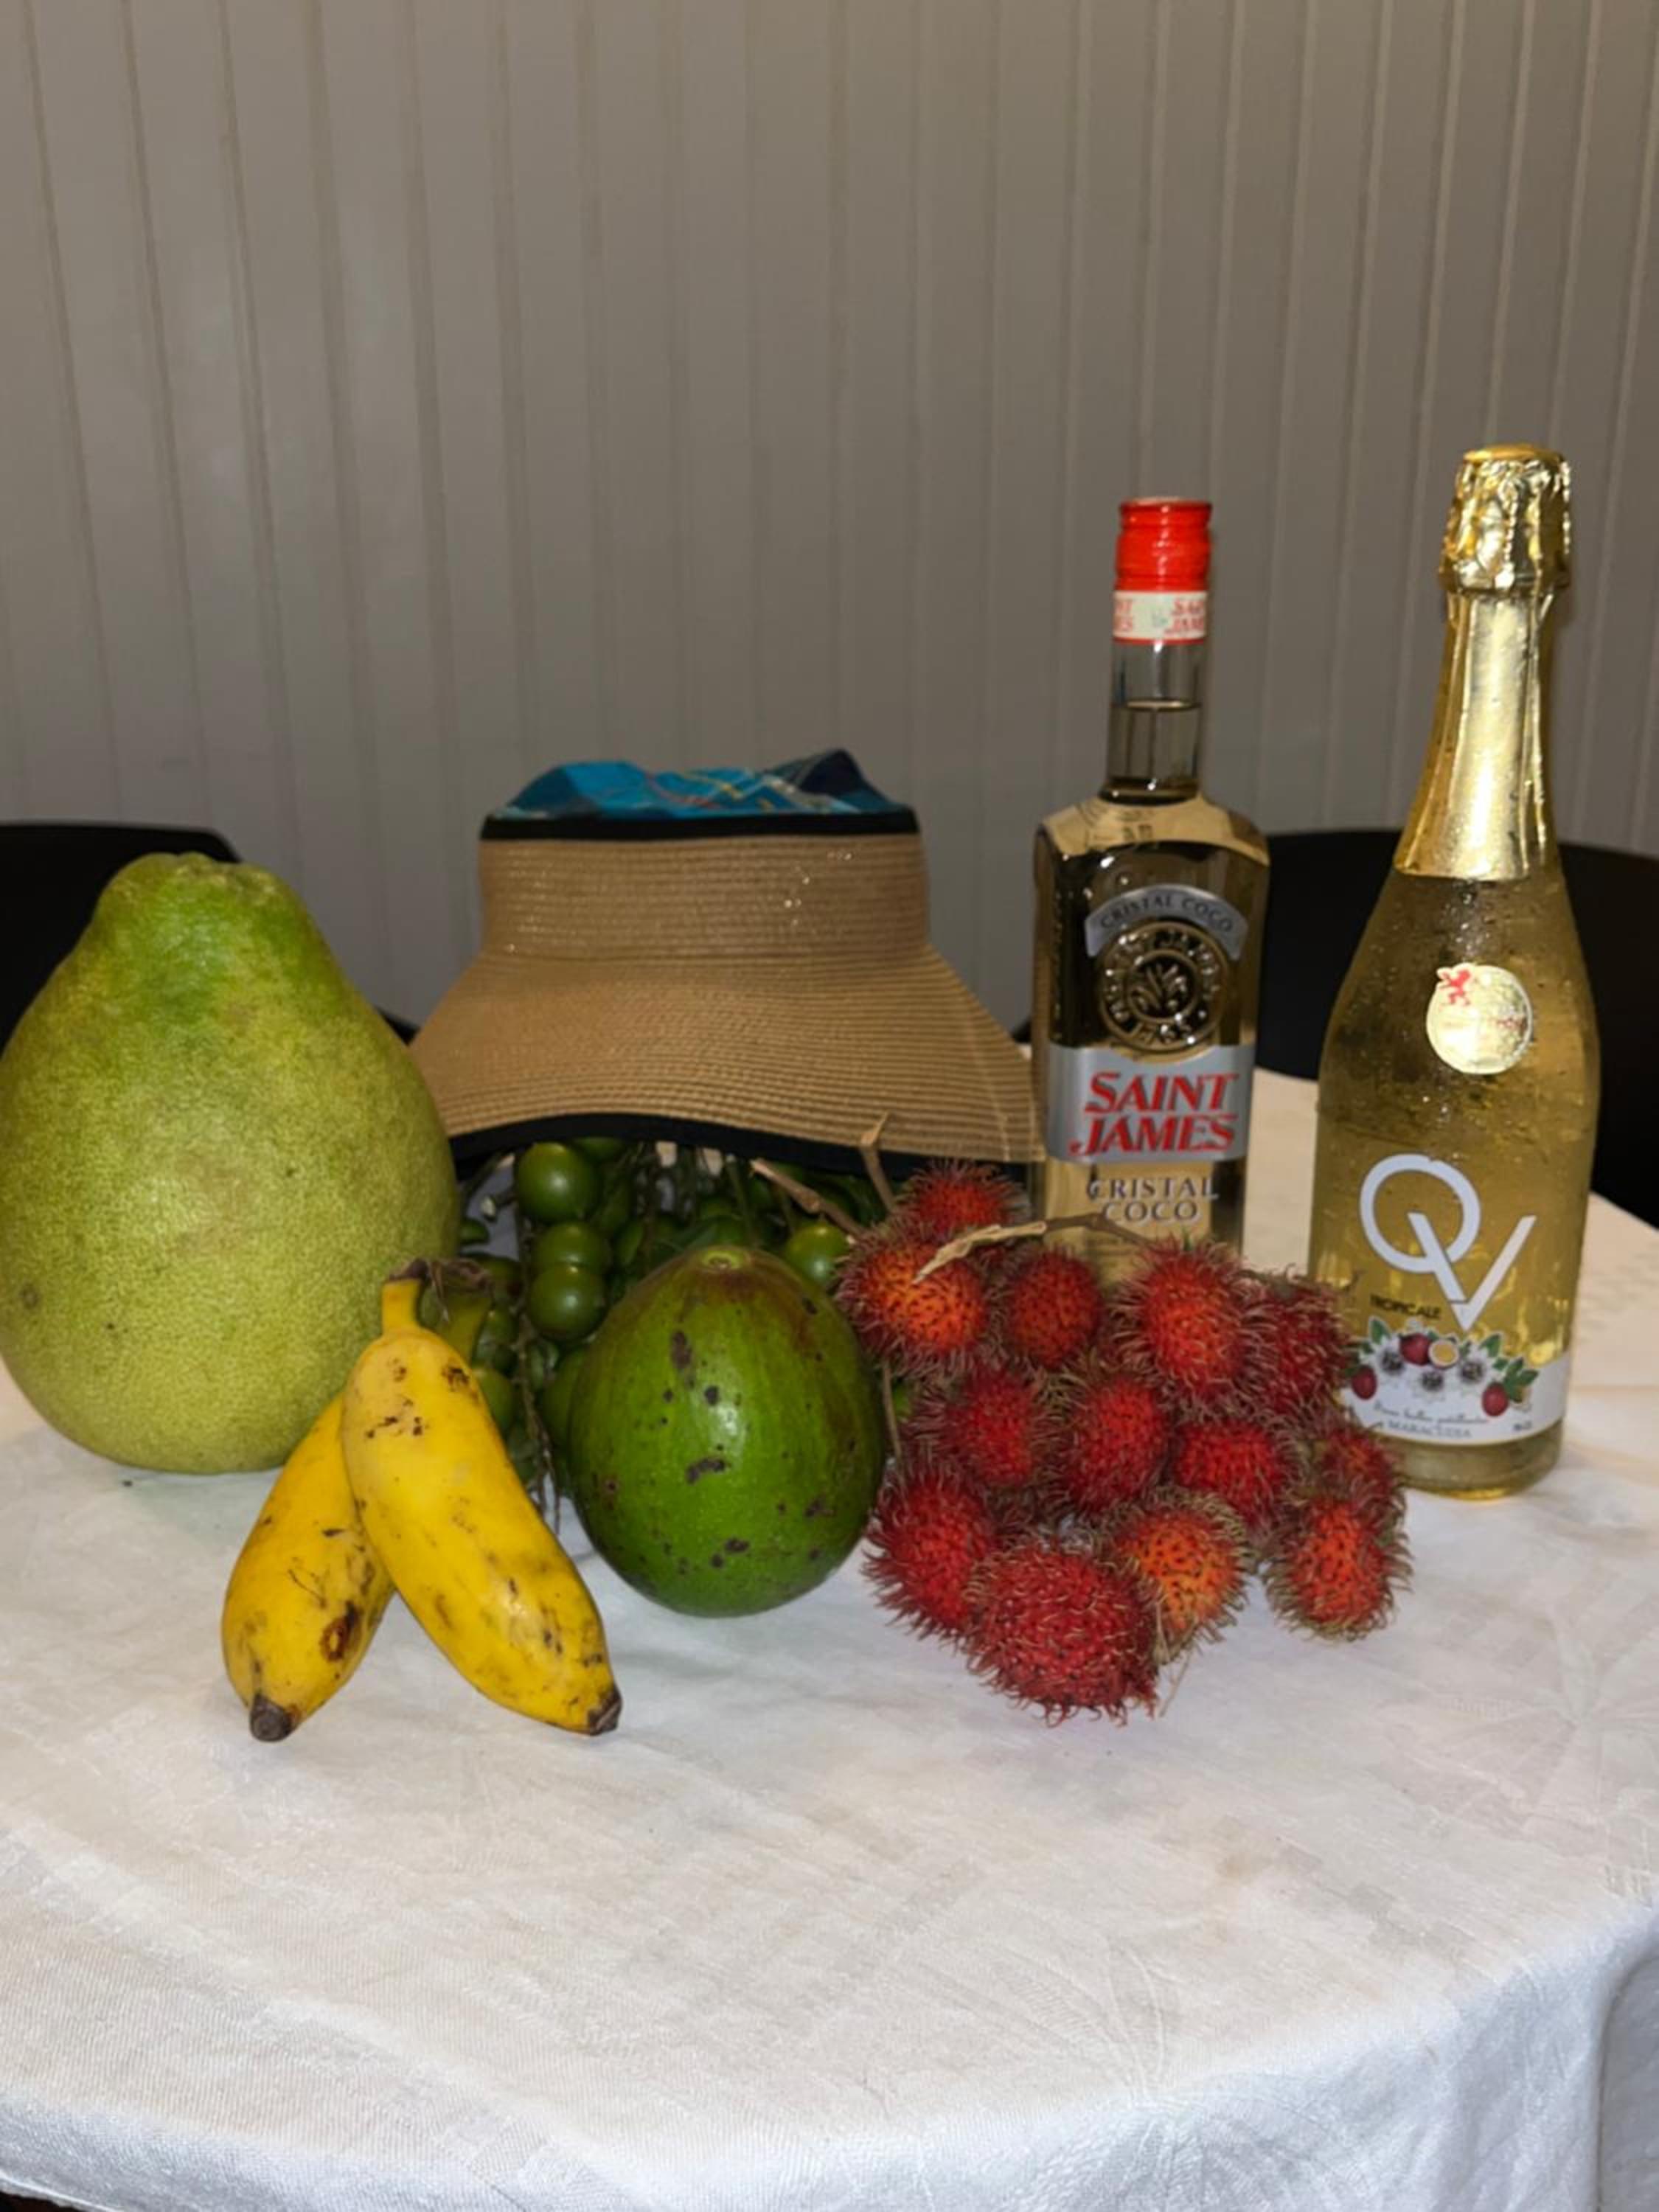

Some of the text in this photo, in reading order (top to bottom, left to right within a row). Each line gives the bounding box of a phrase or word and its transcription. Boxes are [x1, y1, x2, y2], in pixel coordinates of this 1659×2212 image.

[1100, 895, 1234, 933] CRISTAL COCO
[1085, 1071, 1240, 1113] SAINT
[1068, 1113, 1238, 1156] JAMES
[1086, 1177, 1219, 1200] CRISTAL
[1103, 1200, 1200, 1224] COCO
